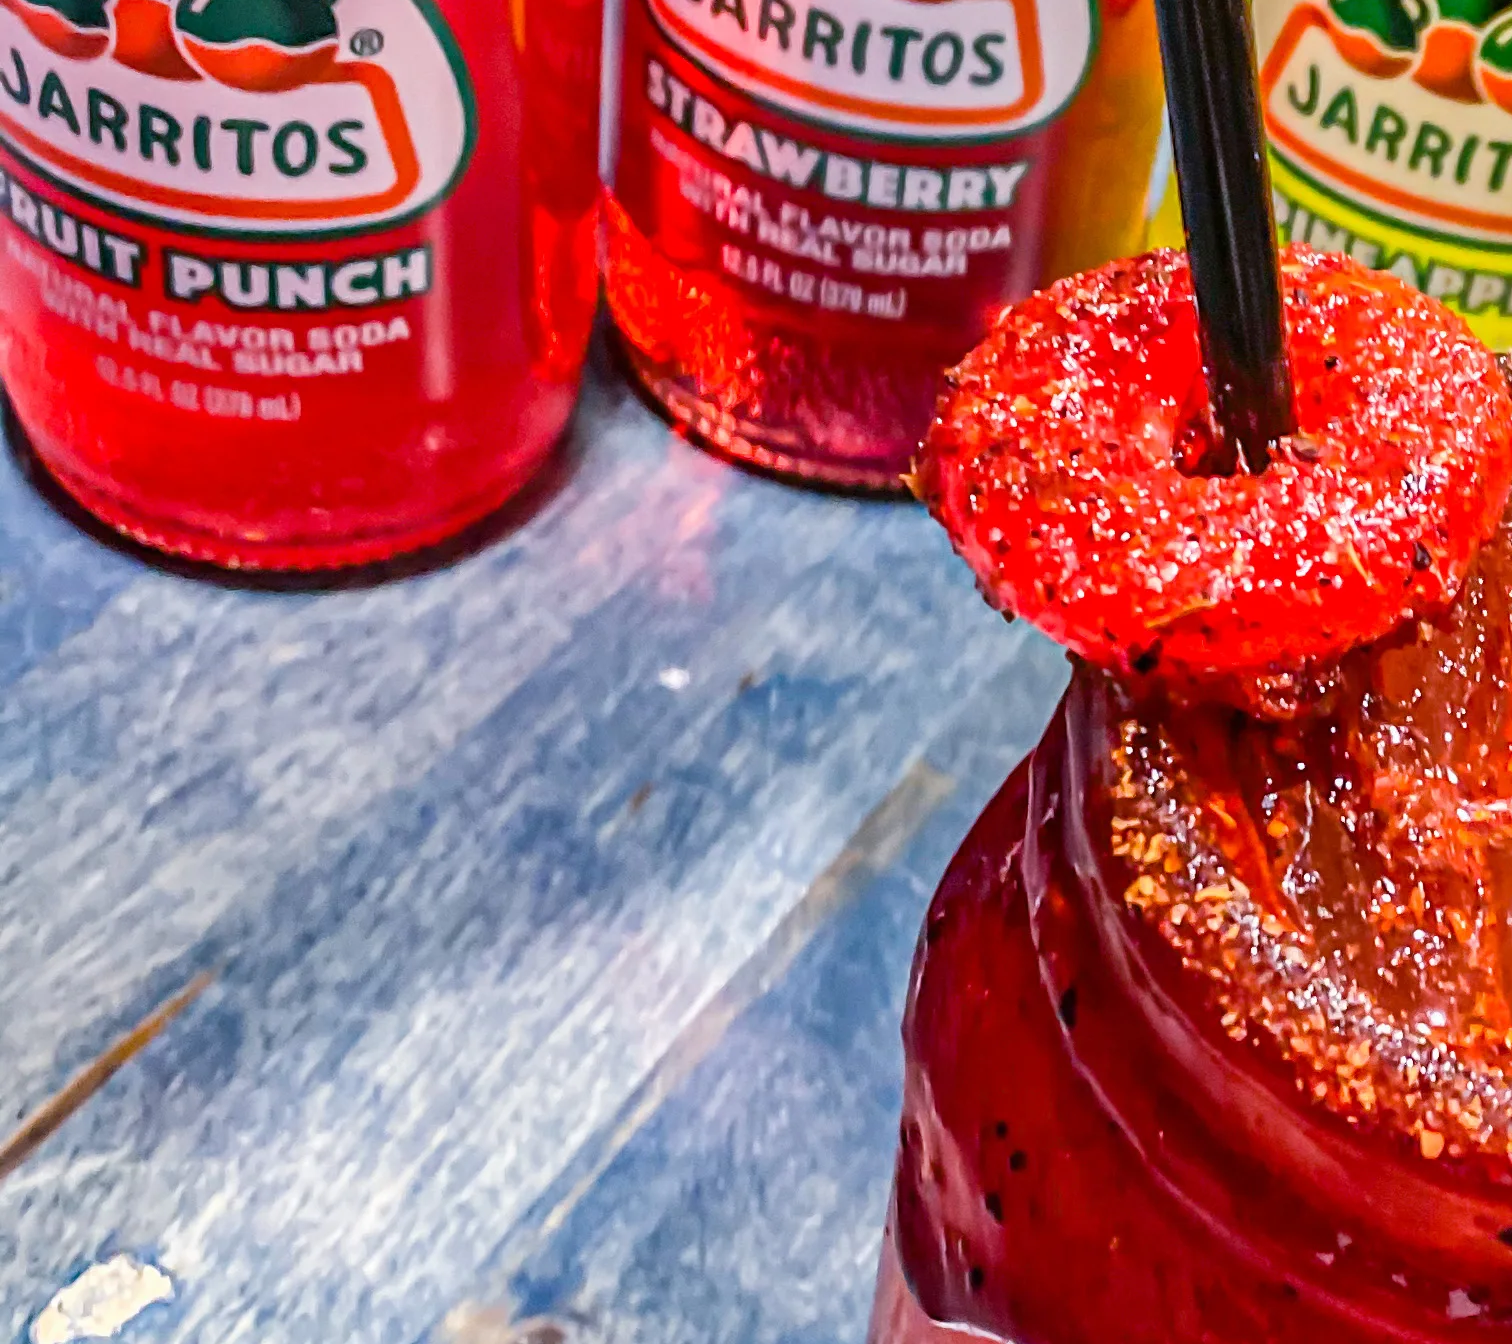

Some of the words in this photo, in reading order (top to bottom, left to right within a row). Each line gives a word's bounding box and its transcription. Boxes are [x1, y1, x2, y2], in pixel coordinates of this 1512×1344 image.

[0, 48, 368, 177] JARRITOS
[647, 60, 1028, 210] STRAWBERRY
[168, 248, 428, 308] PUNCH
